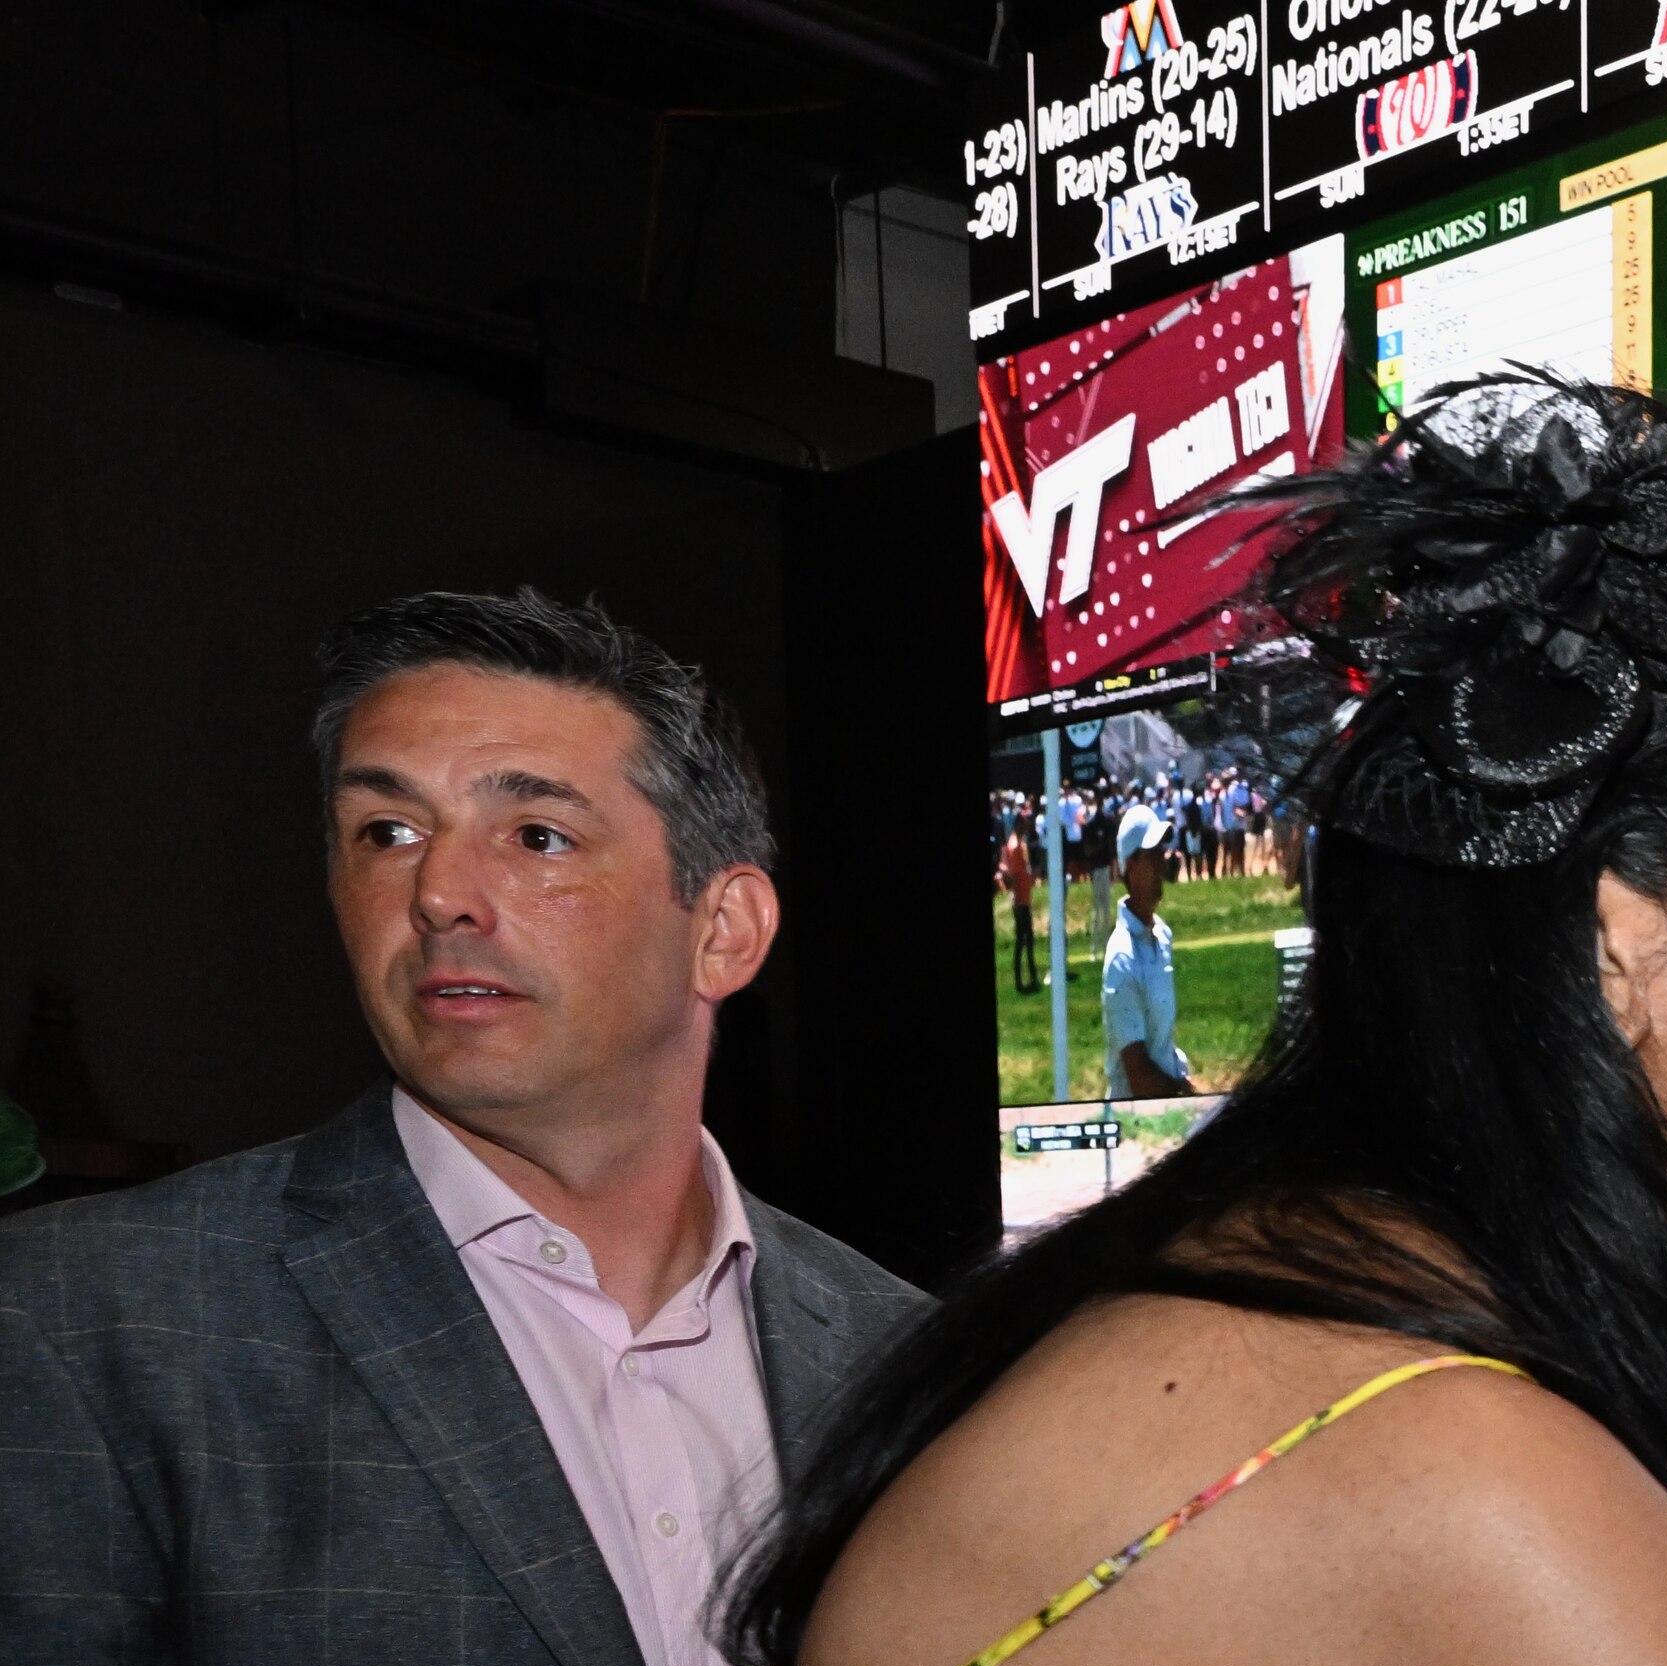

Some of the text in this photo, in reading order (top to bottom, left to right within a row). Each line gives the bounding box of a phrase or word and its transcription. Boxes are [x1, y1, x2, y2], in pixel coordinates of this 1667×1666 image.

[1037, 14, 1258, 154] Marlins (20-25)
[1272, 9, 1435, 116] Nationals
[1056, 87, 1238, 206] Rays (29-14)
[1597, 166, 1634, 191] POOL
[1374, 195, 1528, 274] PREAKNESS 151
[1386, 284, 1396, 304] 1
[1385, 335, 1397, 356] 3
